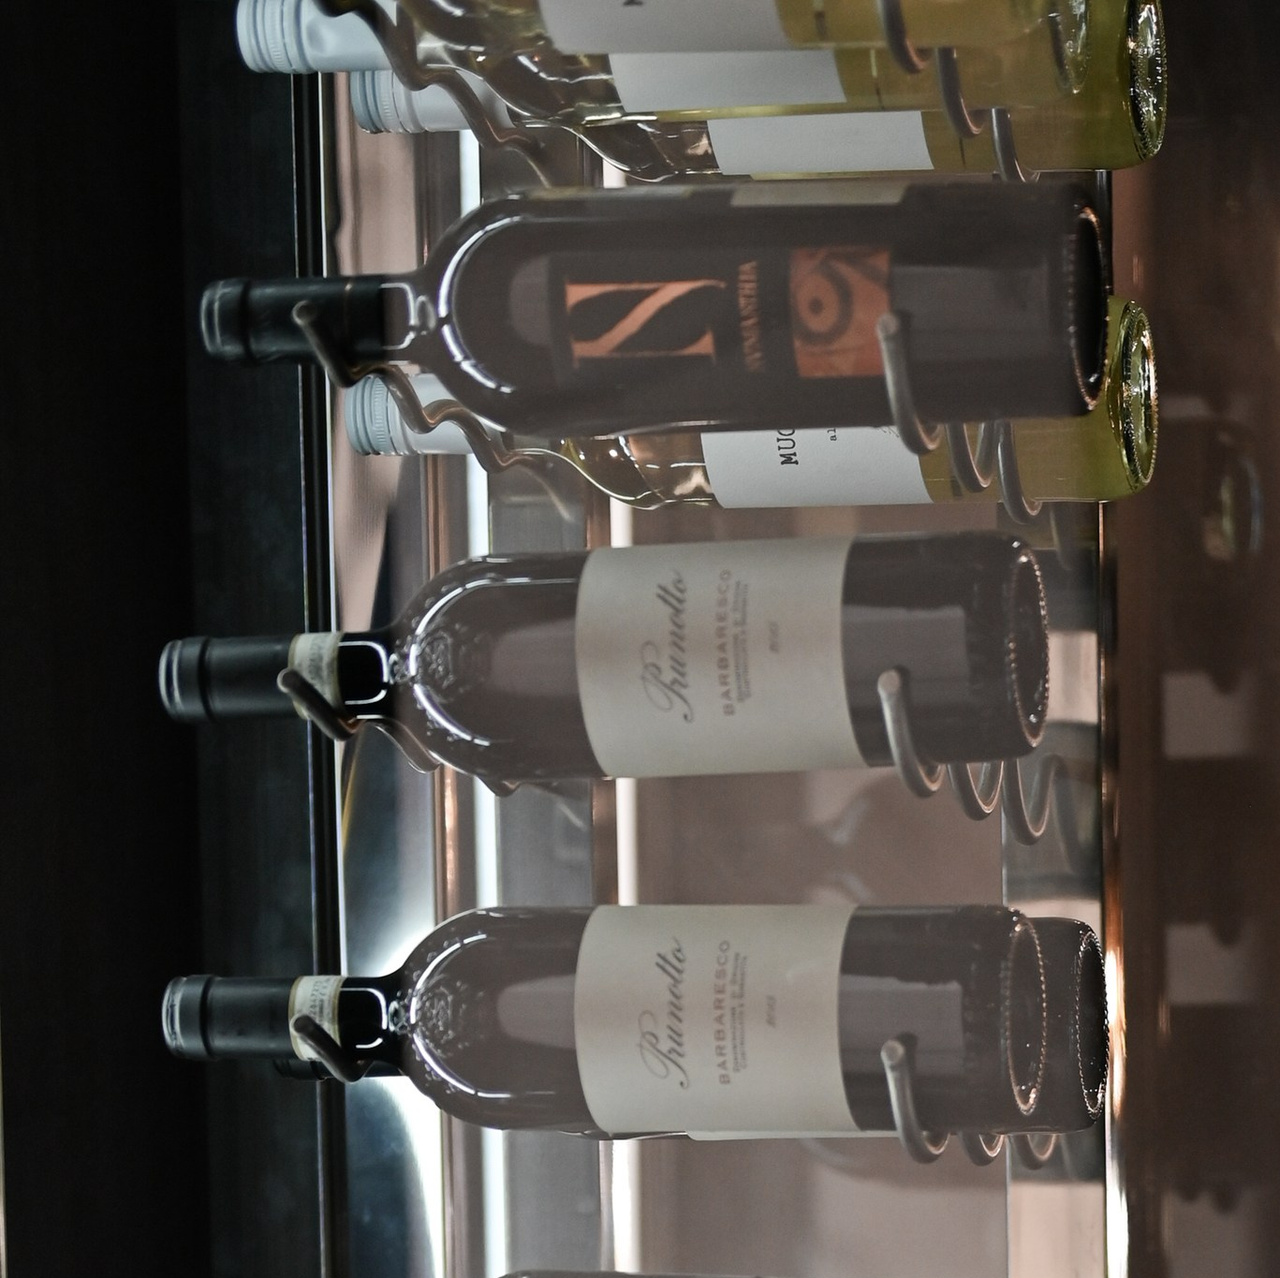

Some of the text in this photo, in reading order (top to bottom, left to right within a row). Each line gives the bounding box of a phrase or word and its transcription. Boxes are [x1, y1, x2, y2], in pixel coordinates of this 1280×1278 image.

[564, 277, 726, 367] N
[640, 568, 694, 723] Prunotto
[714, 568, 736, 717] BARBARESCO
[636, 934, 690, 1090] Prunotto
[712, 940, 731, 1085] BARBARESCO
